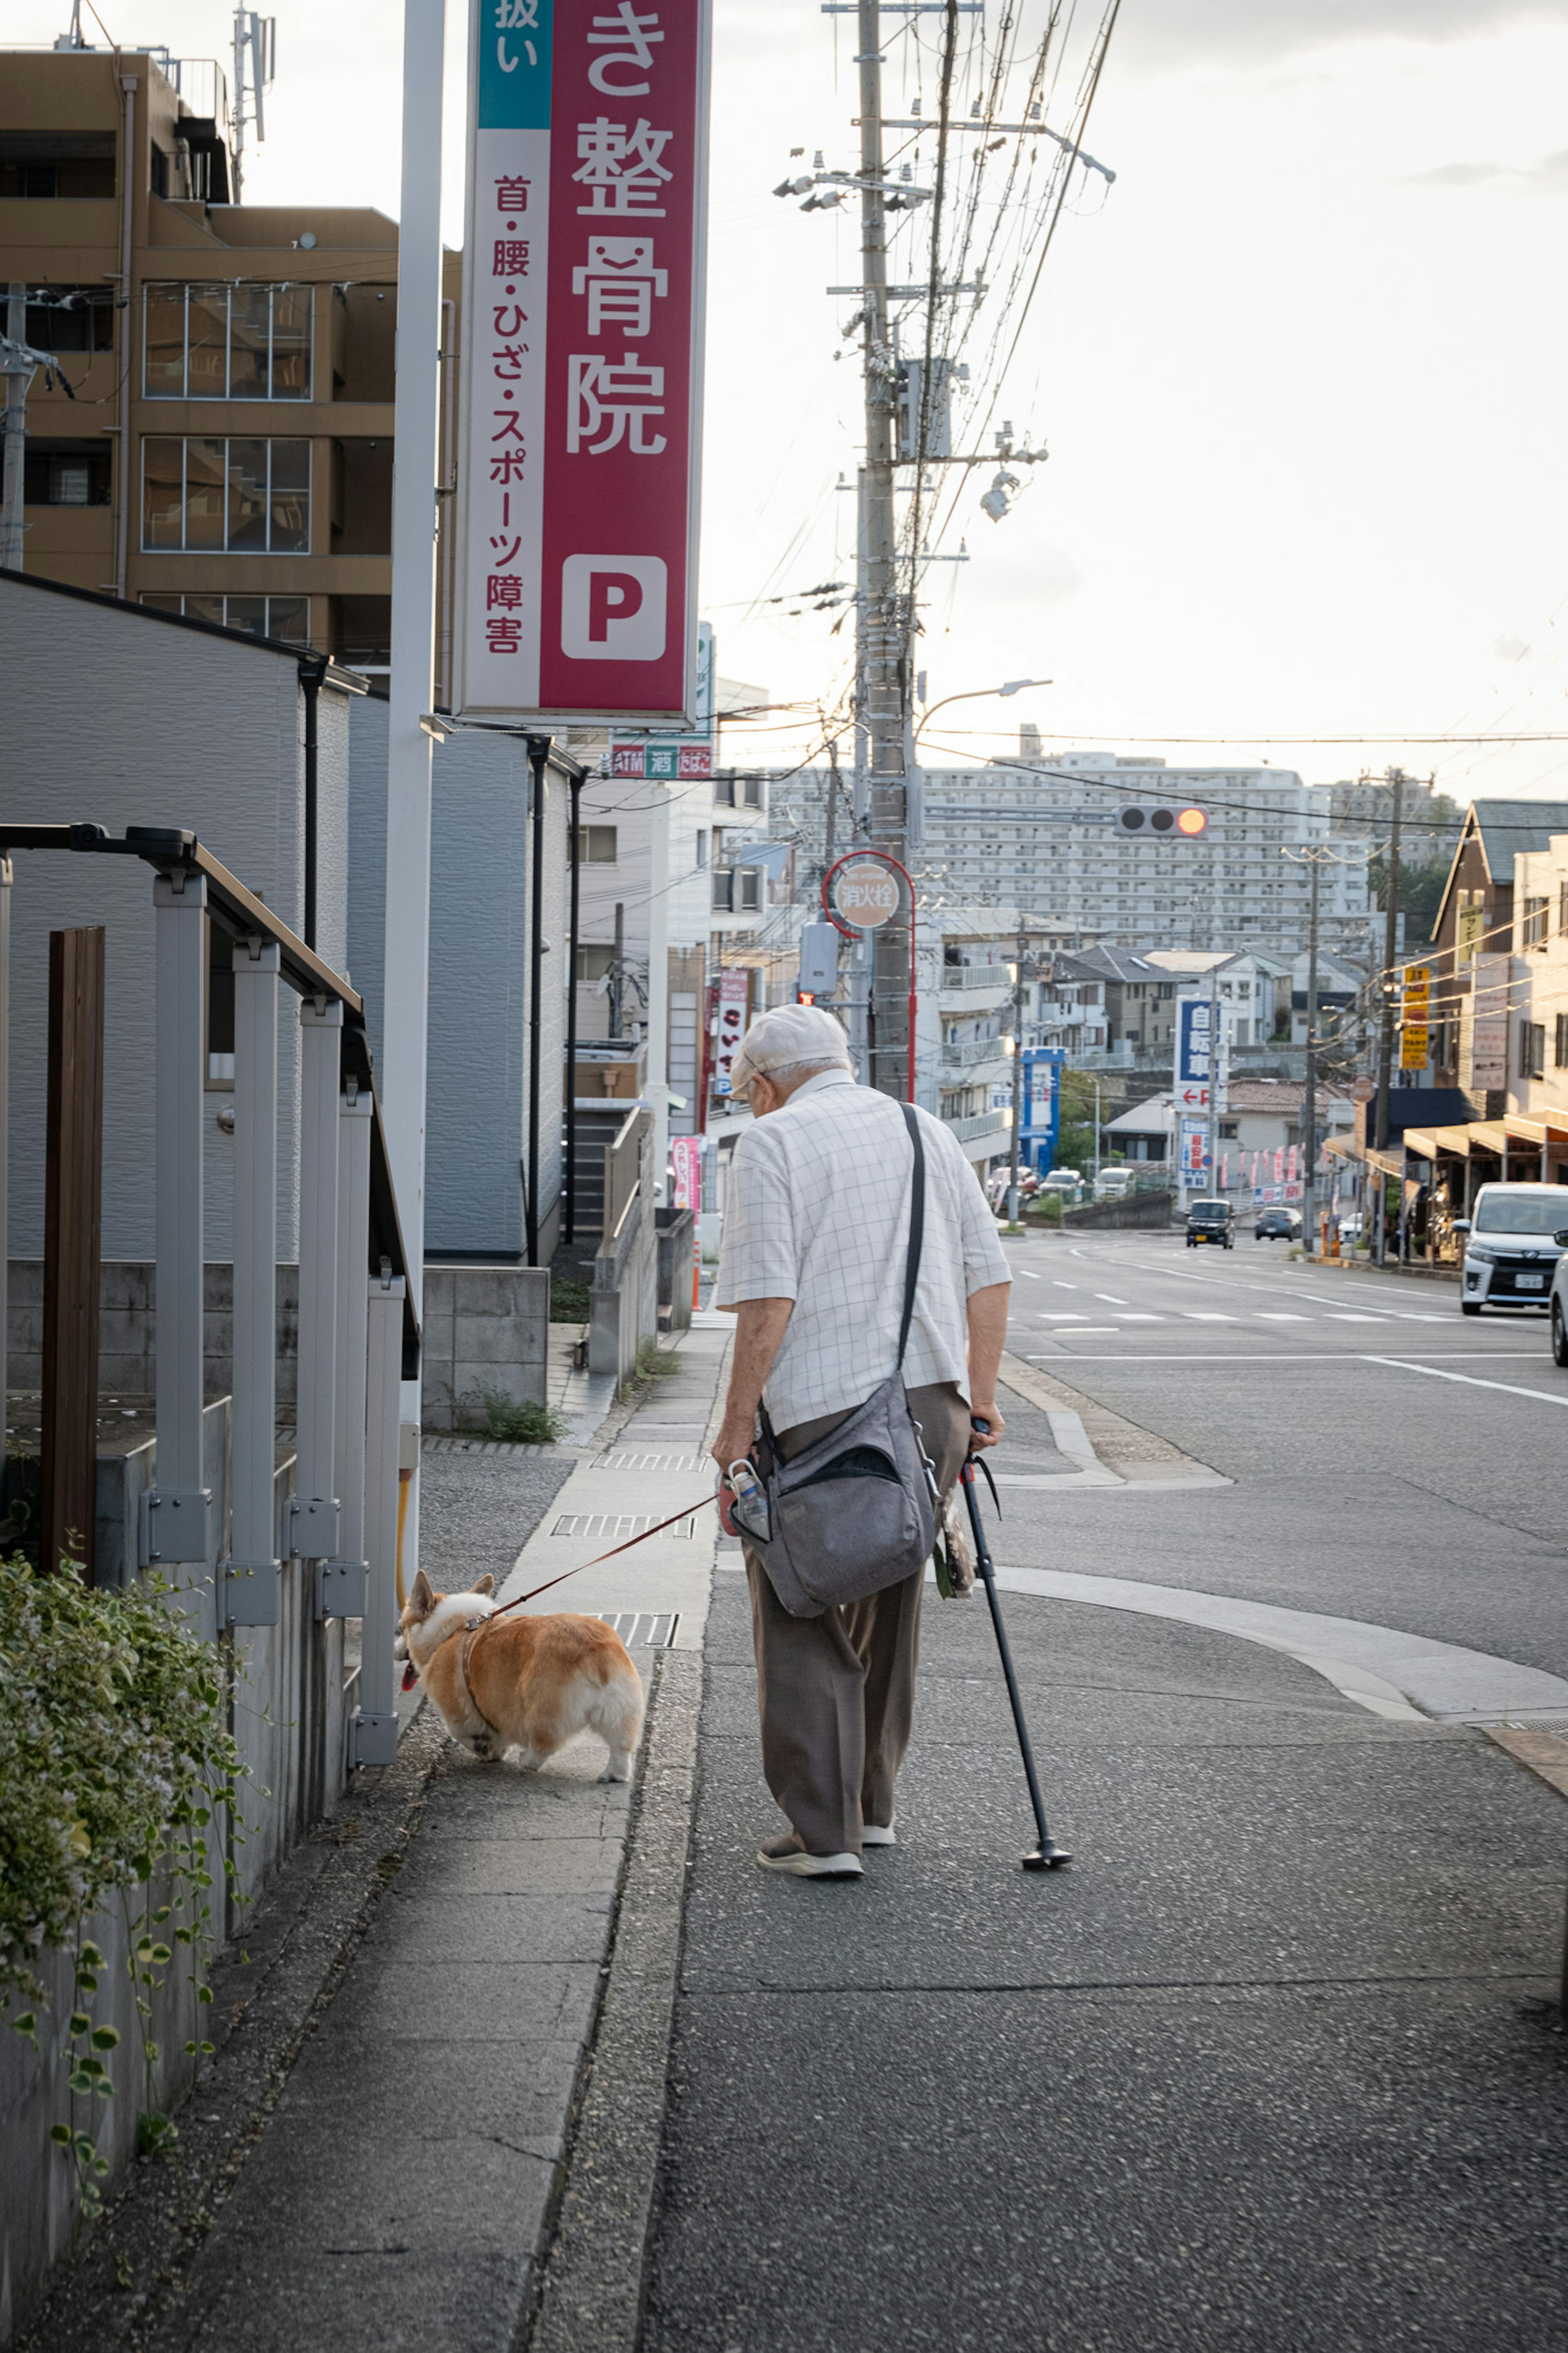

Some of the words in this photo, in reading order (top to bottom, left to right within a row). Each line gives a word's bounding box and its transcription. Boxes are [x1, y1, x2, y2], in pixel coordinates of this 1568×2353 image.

[567, 1, 673, 455] き整骨院
[485, 175, 531, 653] 首・腰・ひざ・スポーツ障害
[588, 571, 643, 642] P
[614, 751, 644, 772] ATM
[652, 752, 672, 772] 酒
[679, 752, 710, 773] たばこ
[842, 883, 893, 908] 消火栓
